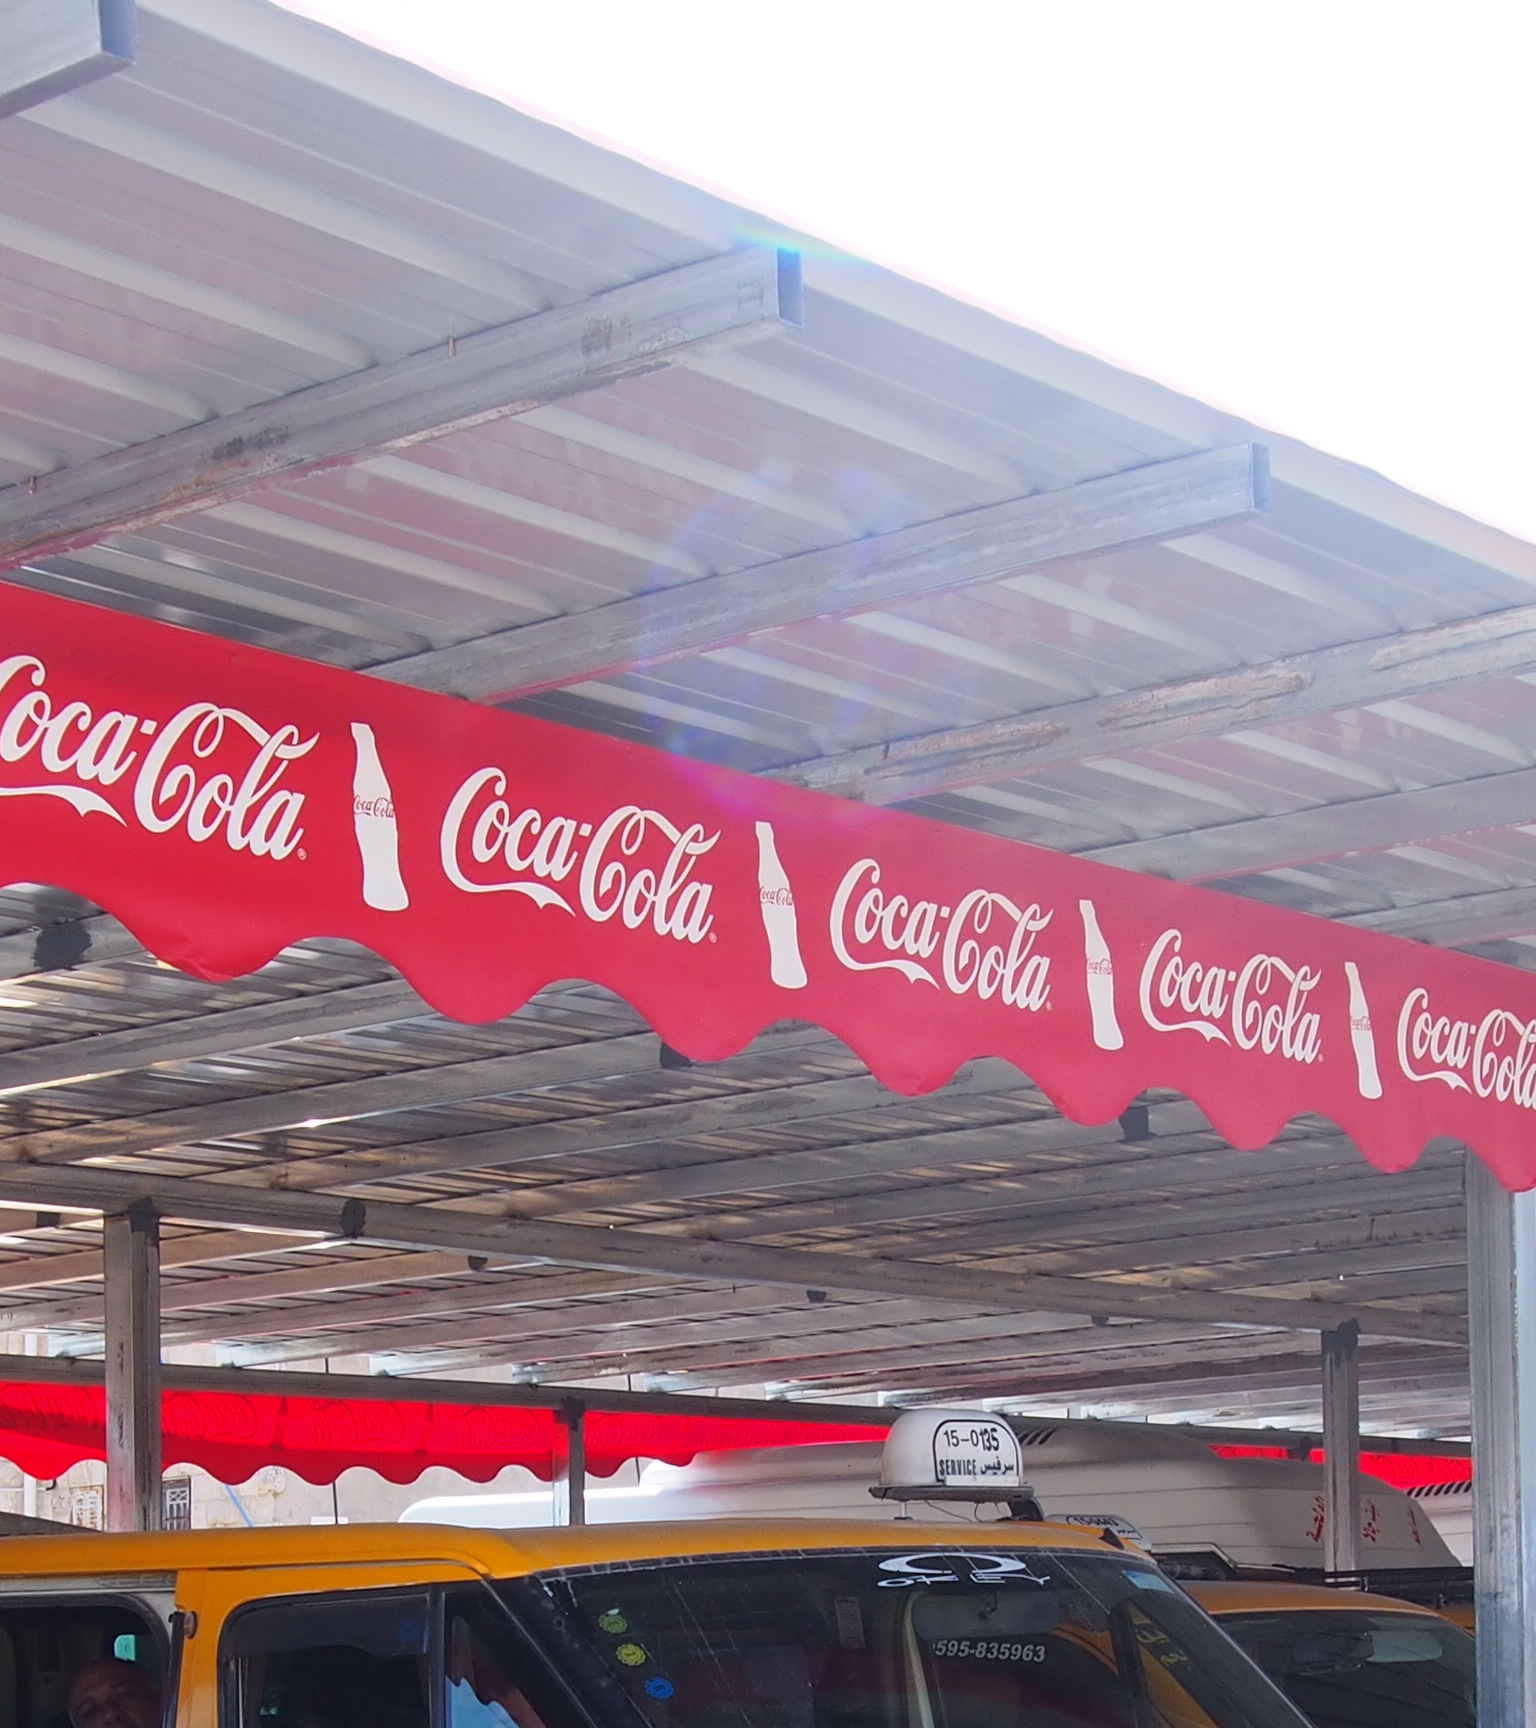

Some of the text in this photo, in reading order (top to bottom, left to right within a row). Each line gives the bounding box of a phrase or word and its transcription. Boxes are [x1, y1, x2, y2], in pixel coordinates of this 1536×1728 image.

[441, 767, 721, 944] Coca-Cola
[830, 858, 1054, 1012] Coca-Cola
[1140, 929, 1322, 1064] Coca-Cola
[939, 1456, 1014, 1477] SERVICE سرفيس
[942, 1427, 1000, 1452] 15-0135
[932, 1639, 1046, 1663] 595-835963
